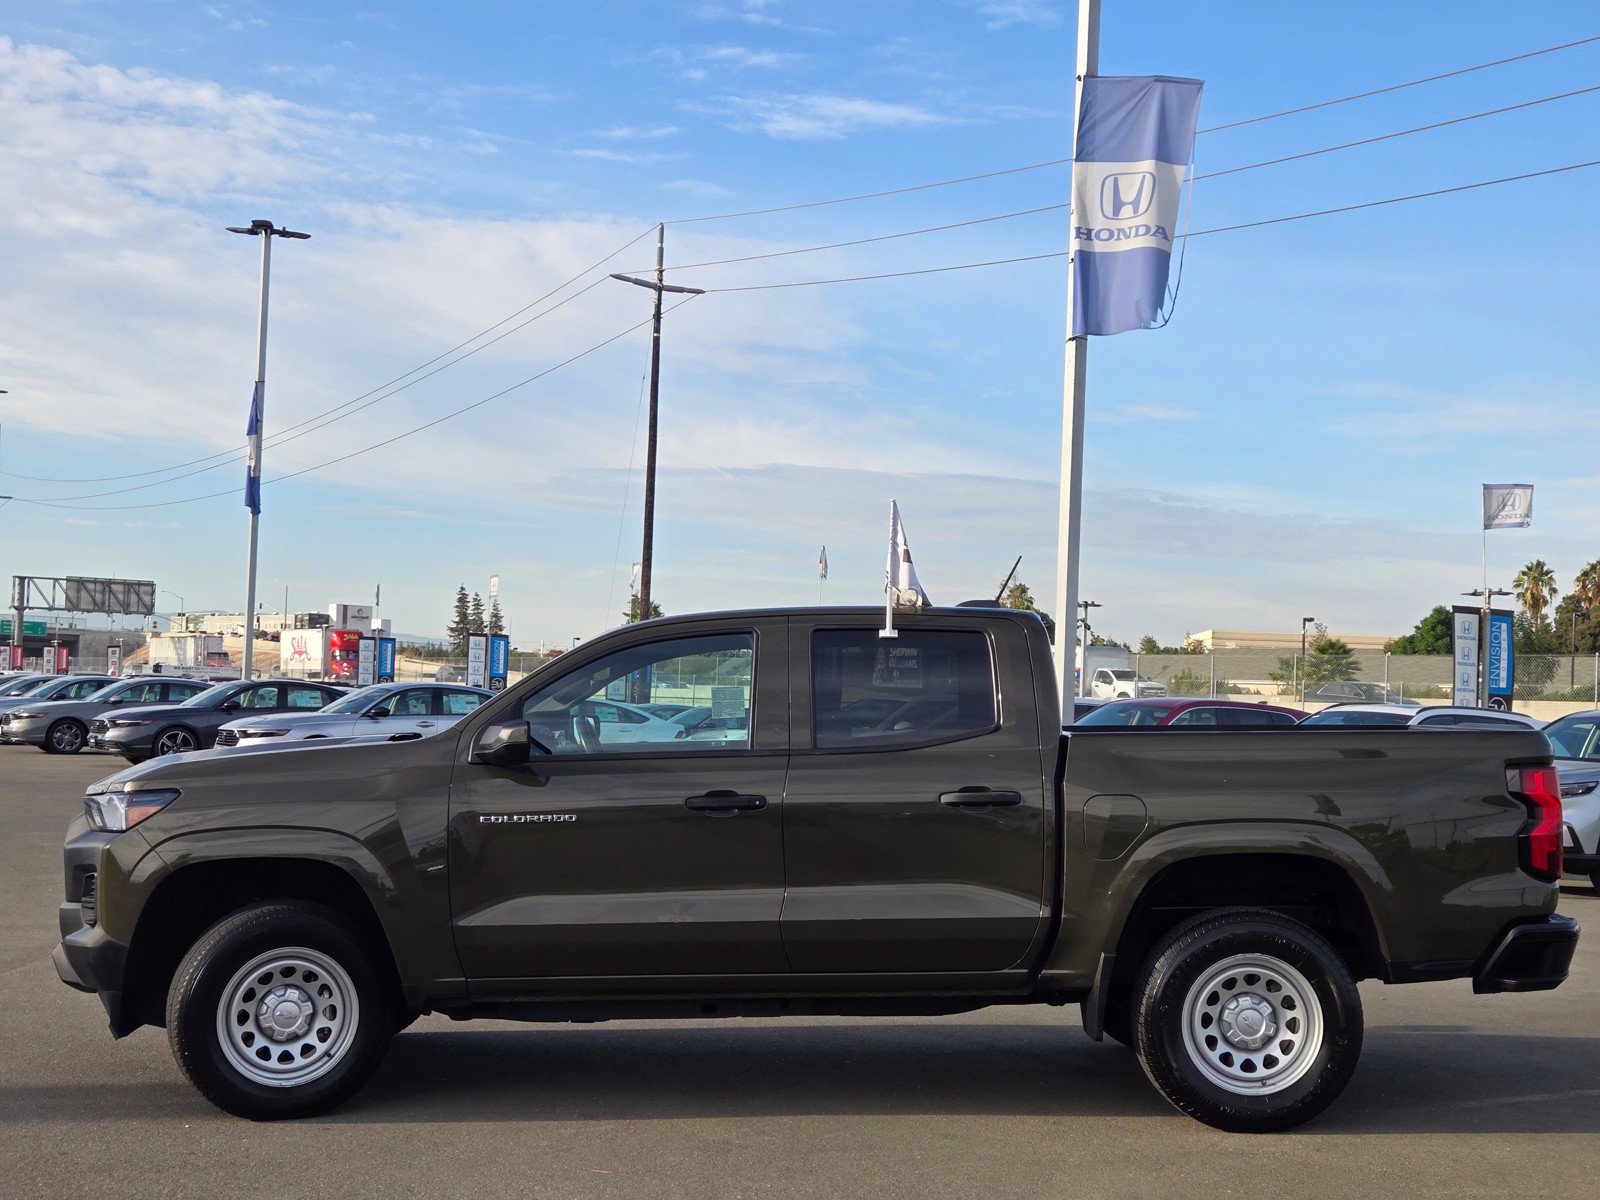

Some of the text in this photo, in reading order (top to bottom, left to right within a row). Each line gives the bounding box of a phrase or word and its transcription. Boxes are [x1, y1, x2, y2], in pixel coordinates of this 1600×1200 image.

[1074, 224, 1170, 242] HONDA
[492, 640, 500, 674] ENVISION
[1490, 621, 1501, 688] ENVISION
[480, 814, 577, 823] COLORADO
